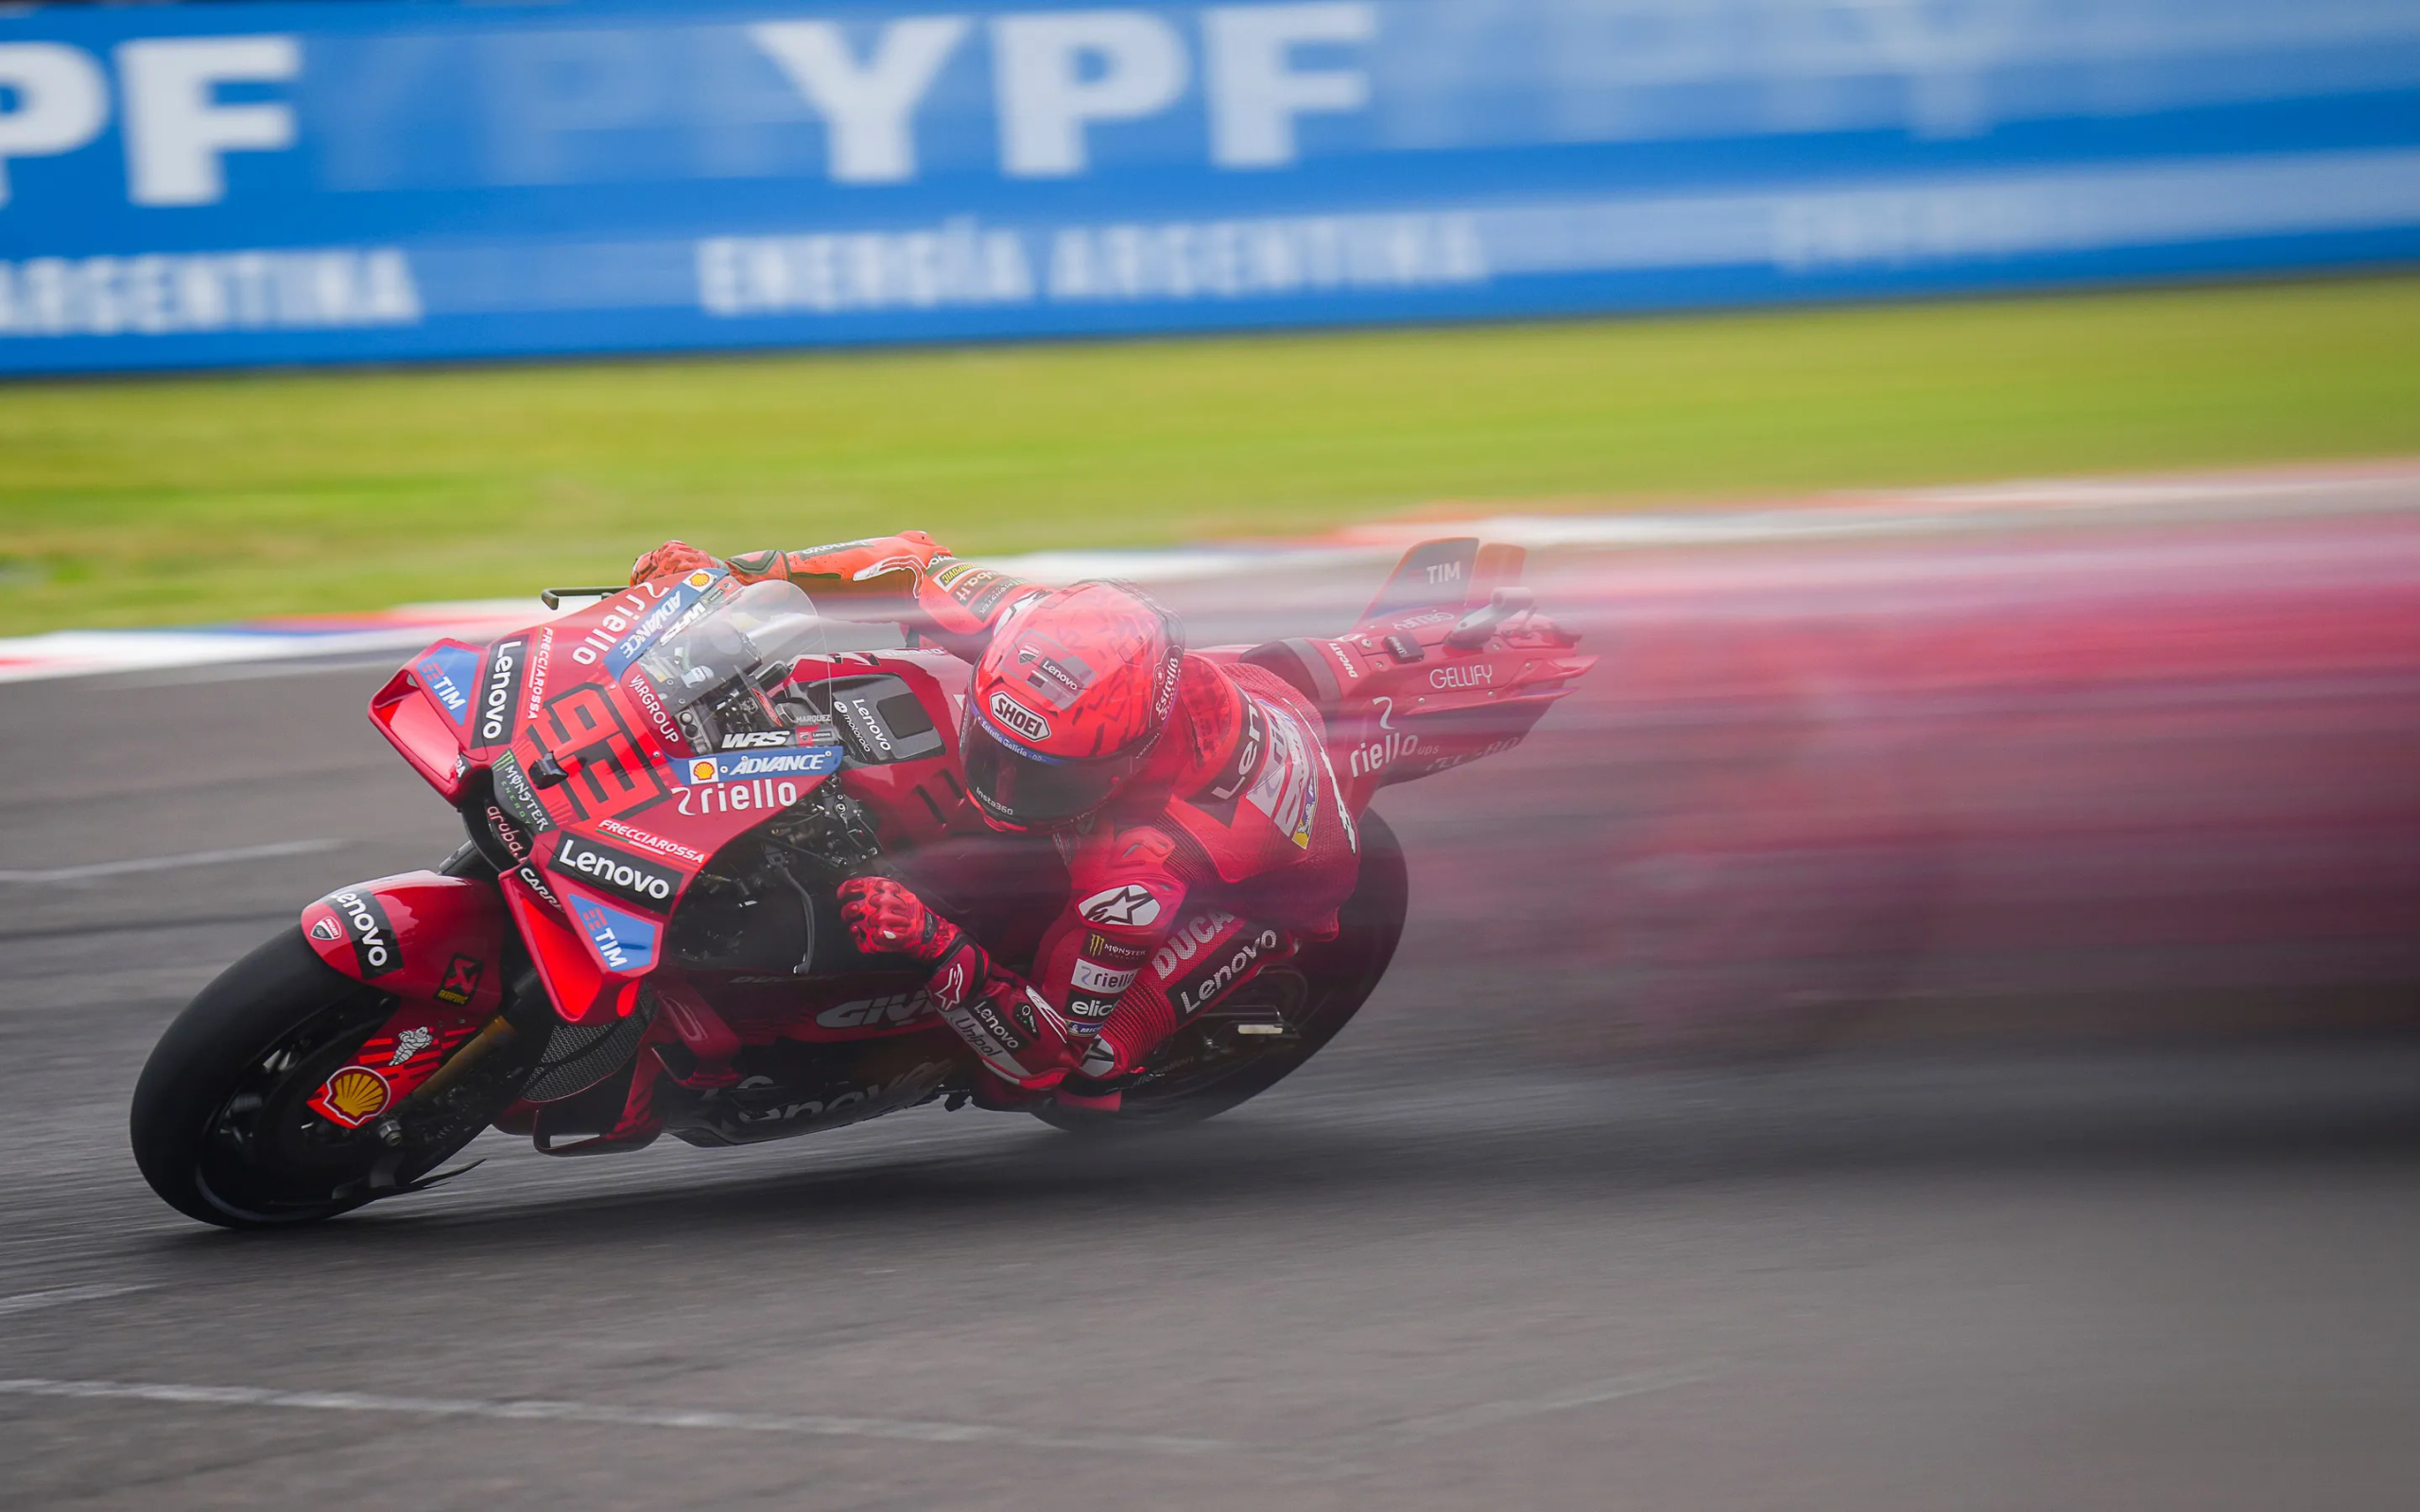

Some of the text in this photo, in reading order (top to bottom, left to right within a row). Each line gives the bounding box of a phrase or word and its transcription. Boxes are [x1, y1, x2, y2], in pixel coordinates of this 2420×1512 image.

[749, 4, 1376, 181] YPF
[1047, 212, 1491, 301] ARGENTINA
[1426, 561, 1461, 586] TIM
[572, 593, 647, 665] riello
[620, 591, 682, 659] ADVANCE
[527, 627, 554, 720] FRECCIAROSSA
[1042, 661, 1078, 690] Lenovo
[1327, 643, 1359, 679] DUCATI
[1429, 664, 1493, 690] GELLIFY
[431, 676, 466, 711] TIM
[482, 641, 522, 739] Lenovo
[1155, 657, 1179, 716] Estrella
[721, 730, 790, 749] WRS
[796, 713, 831, 724] MARQUEZ
[842, 713, 871, 753] motorola
[852, 698, 891, 750] Lenovo
[981, 720, 1003, 744] Estrella
[1002, 738, 1028, 758] Galicia
[994, 698, 1043, 737] SHOEI
[730, 752, 823, 775] ADVANCE
[1350, 732, 1418, 778] riello
[500, 781, 532, 827] ENERGY
[505, 764, 549, 832] MONSTER
[700, 779, 797, 813] riello
[976, 786, 1014, 816] Insta360
[486, 805, 527, 864] aruba.
[597, 818, 706, 864] FRECCIAROSSA
[519, 868, 564, 912] CARR
[559, 839, 670, 900] Lenovo
[595, 927, 628, 968] TIM
[1104, 943, 1147, 957] MONSTER
[1150, 908, 1236, 981] DUCA
[1094, 971, 1134, 989] riello
[1181, 929, 1277, 1014] Lenovo
[954, 1017, 1002, 1057] Unipol
[975, 1001, 1019, 1049] Lenovo
